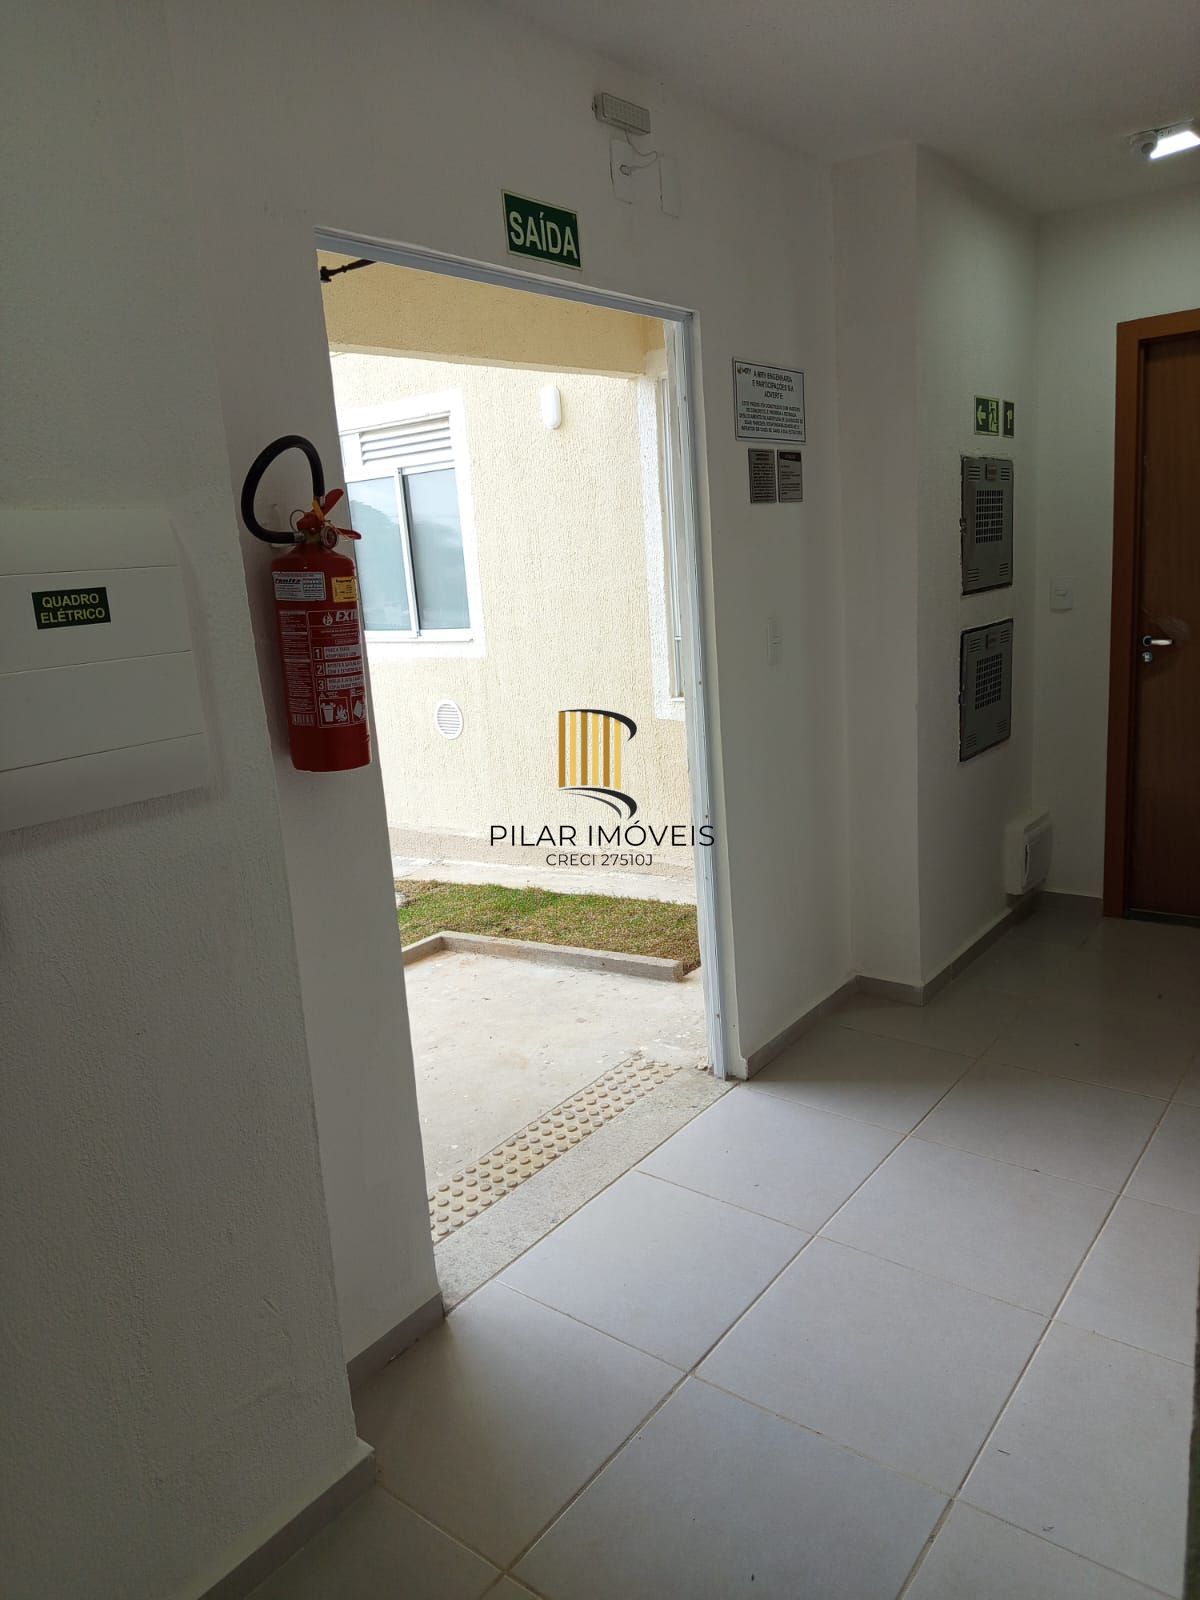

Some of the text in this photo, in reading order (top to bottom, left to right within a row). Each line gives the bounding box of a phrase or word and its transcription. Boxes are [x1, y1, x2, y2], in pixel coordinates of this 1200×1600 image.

[509, 211, 578, 259] SAÍDA
[42, 593, 99, 608] QUADRO
[40, 608, 105, 624] ELÉTRICO
[315, 648, 320, 658] 1
[316, 665, 323, 675] 2
[318, 680, 324, 690] 3
